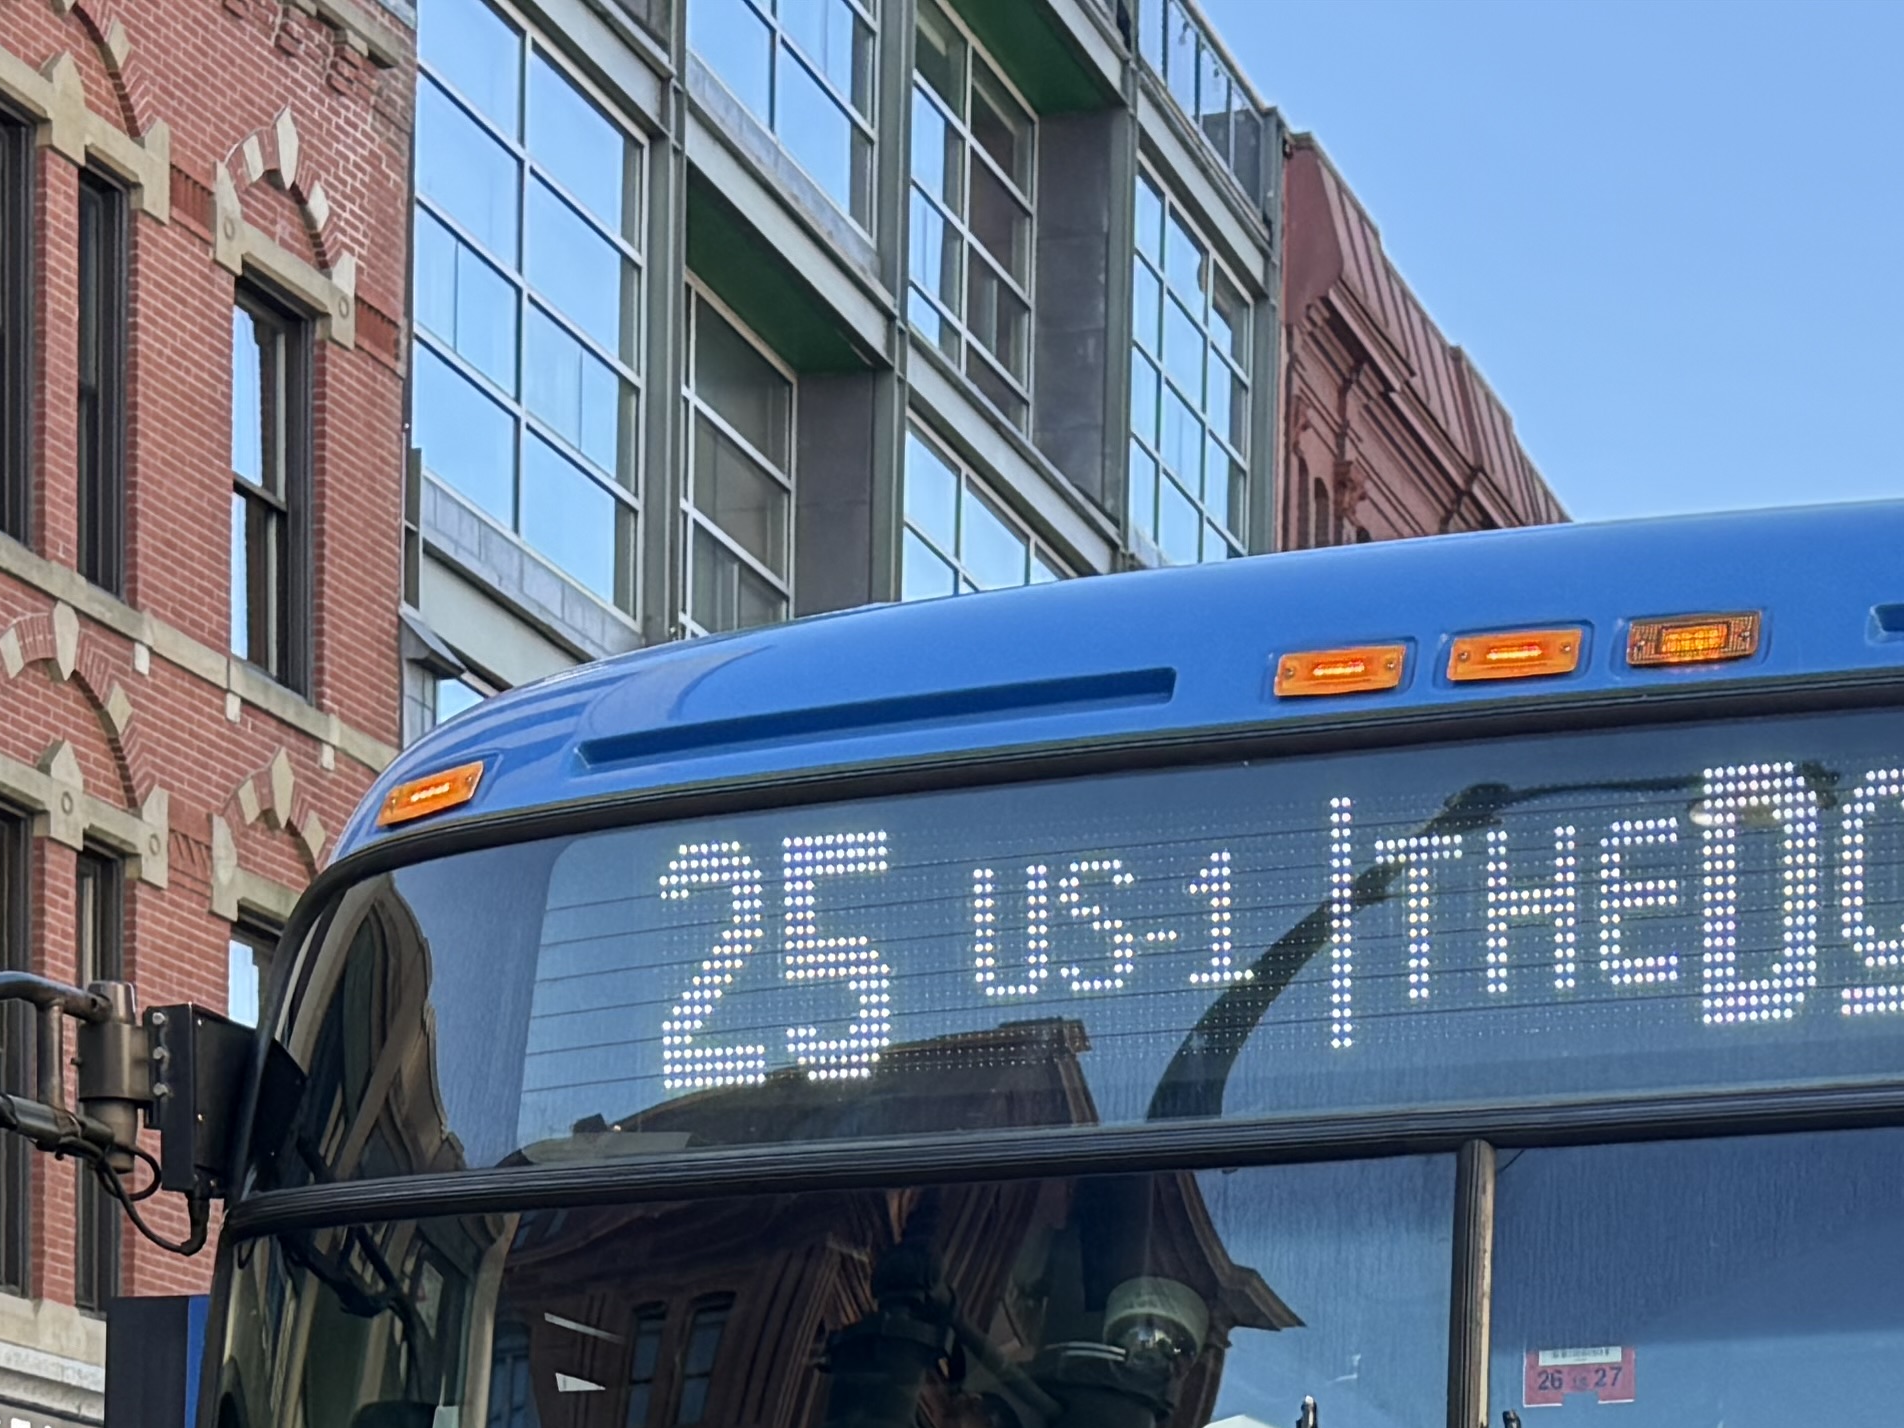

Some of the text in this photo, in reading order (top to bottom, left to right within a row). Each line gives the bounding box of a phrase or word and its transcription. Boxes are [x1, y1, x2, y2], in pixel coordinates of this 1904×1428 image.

[658, 829, 891, 1090] 25
[973, 849, 1256, 996] US-1
[1374, 818, 1679, 1000] THE
[1538, 1368, 1563, 1391] 26
[1594, 1366, 1623, 1388] 27
